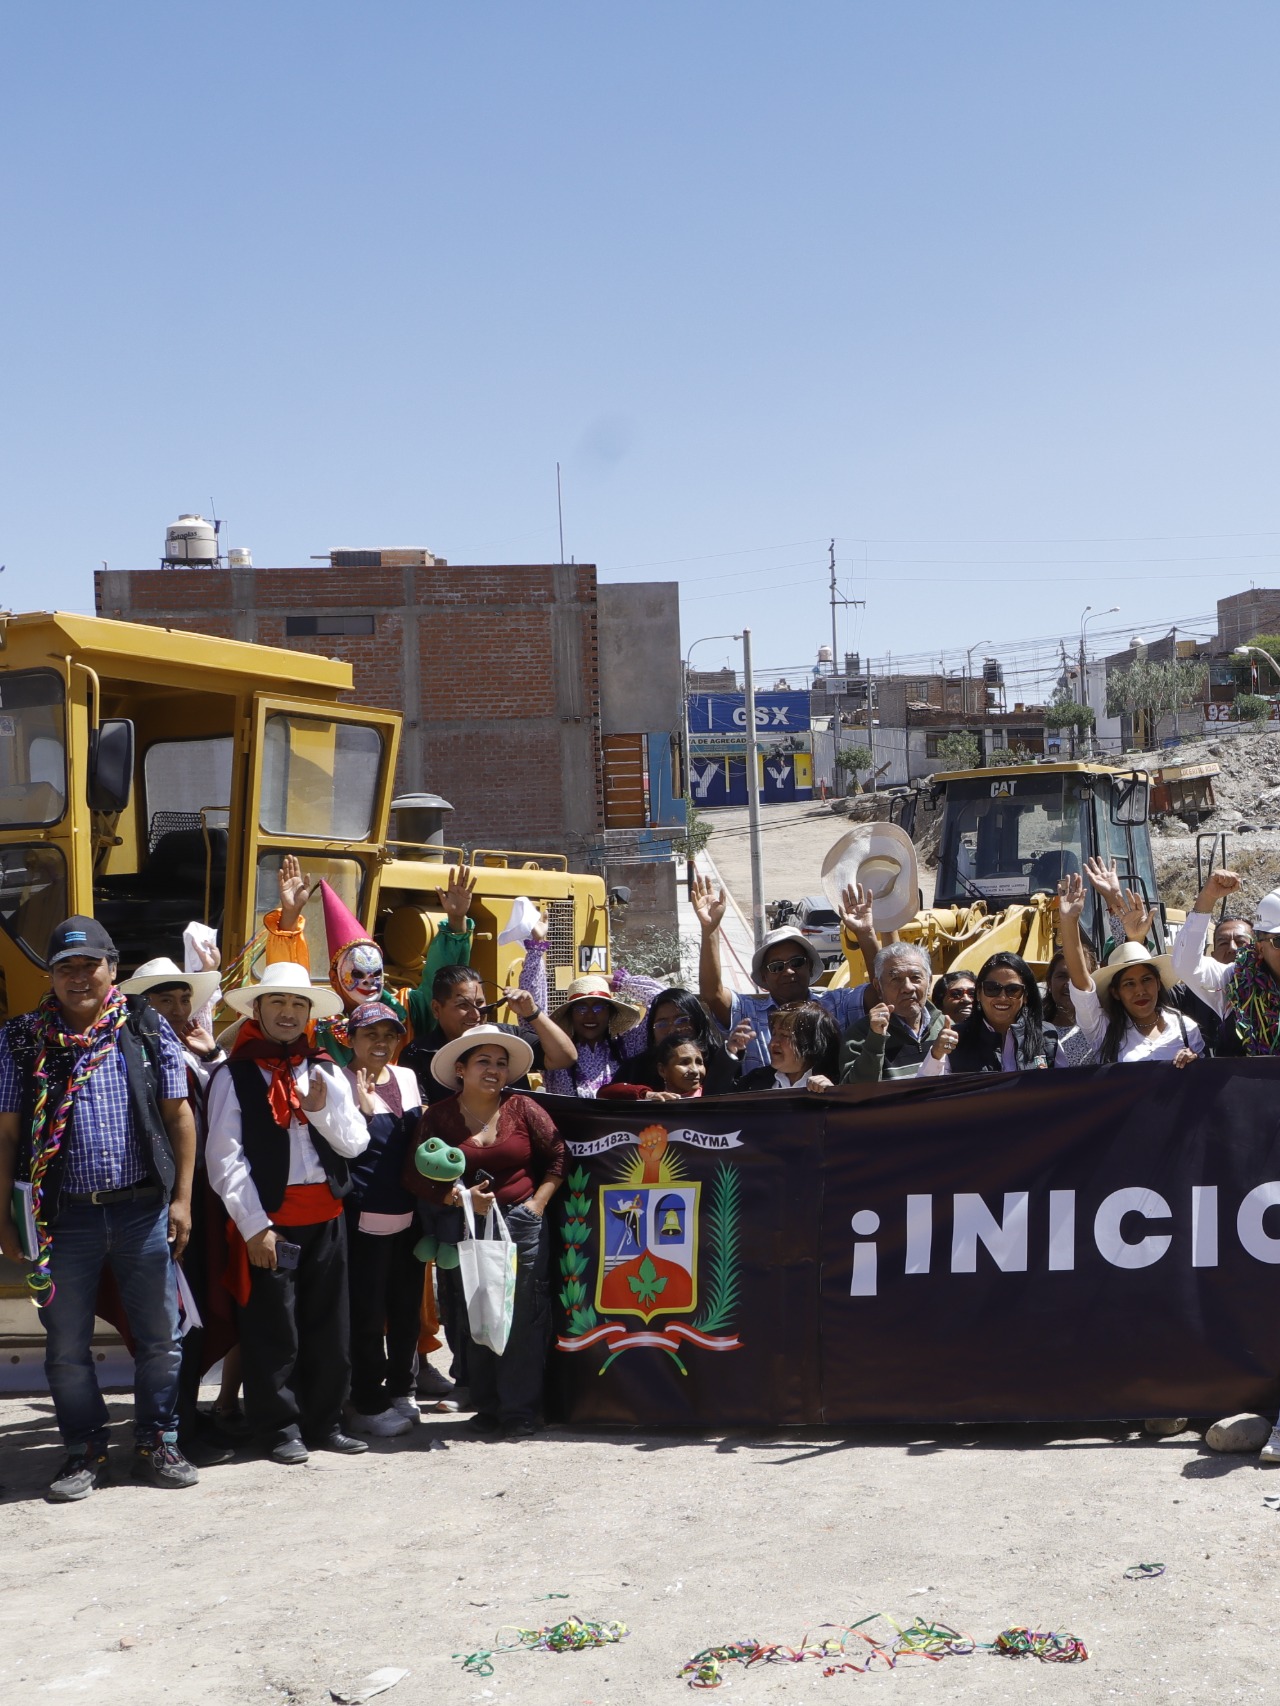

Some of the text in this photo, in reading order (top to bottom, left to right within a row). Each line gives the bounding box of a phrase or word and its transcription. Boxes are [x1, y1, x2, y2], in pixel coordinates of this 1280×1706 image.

[732, 706, 790, 725] GSX
[990, 780, 1018, 798] CAT
[581, 946, 607, 971] CAT
[571, 1133, 630, 1155] 12-11-1823
[682, 1130, 730, 1148] CAYMA
